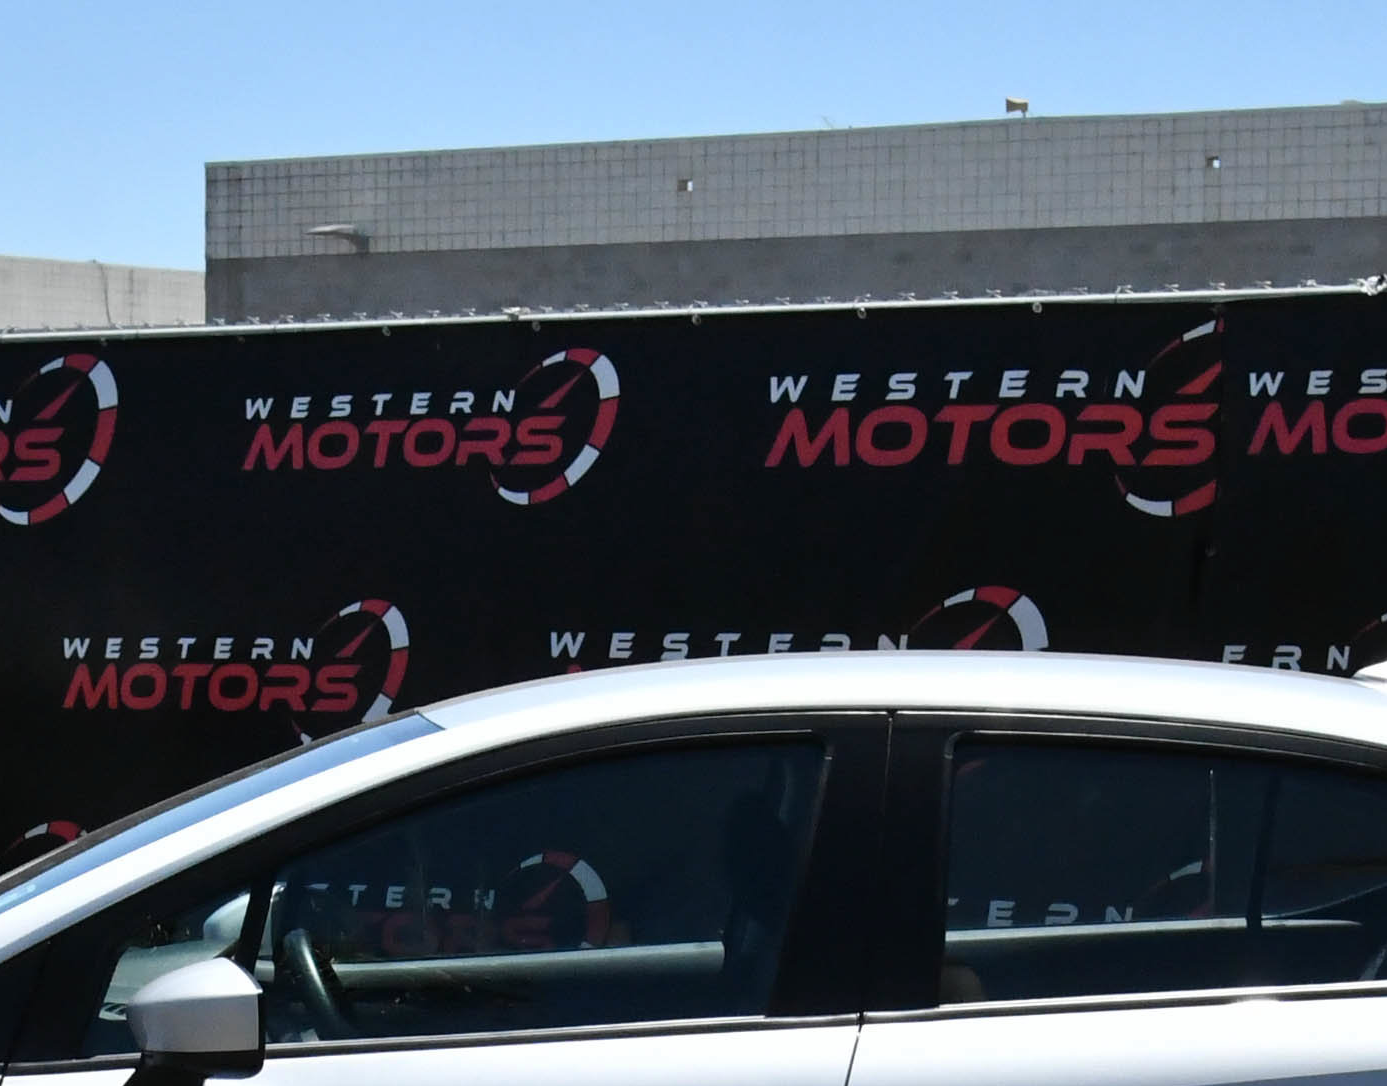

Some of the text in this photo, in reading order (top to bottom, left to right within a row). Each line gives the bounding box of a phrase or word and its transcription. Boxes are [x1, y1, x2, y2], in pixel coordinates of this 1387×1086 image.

[245, 390, 516, 420] WESTERN
[769, 369, 1146, 403] WESTERN
[242, 415, 566, 471] MOTORS
[764, 403, 1219, 467] MOTORS
[63, 637, 314, 660] WESTERN
[62, 663, 361, 711] MOTORS
